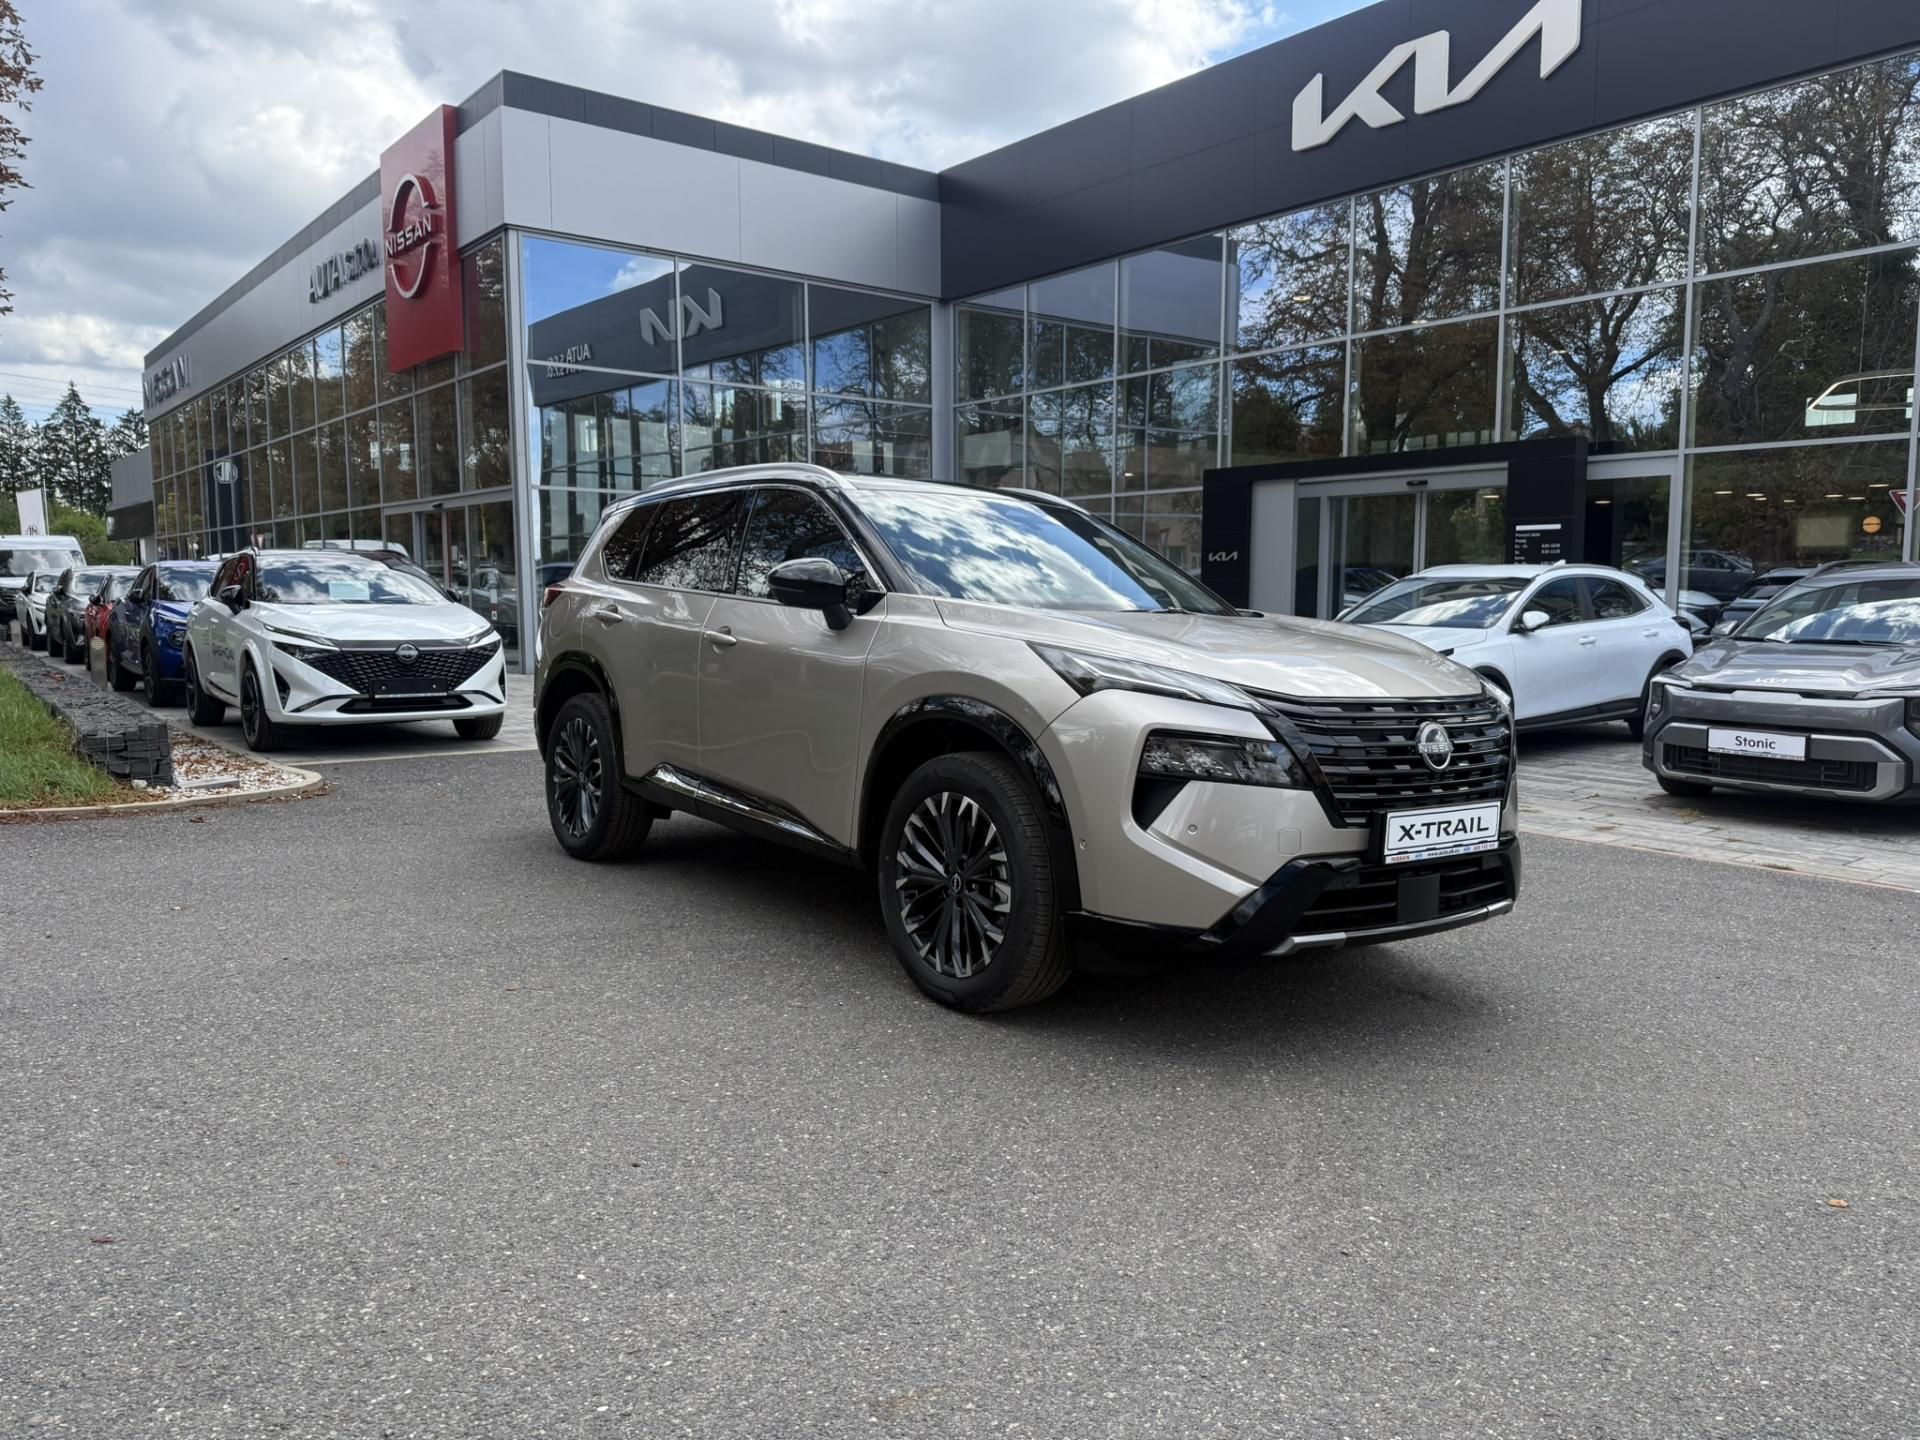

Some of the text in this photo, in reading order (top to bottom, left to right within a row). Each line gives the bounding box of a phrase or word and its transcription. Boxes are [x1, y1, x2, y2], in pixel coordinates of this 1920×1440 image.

[1292, 0, 1583, 152] KIA
[385, 213, 432, 258] NISSAN
[1208, 551, 1238, 561] KIA
[1735, 735, 1776, 750] Stonic
[1397, 816, 1489, 842] X-TRAIL
